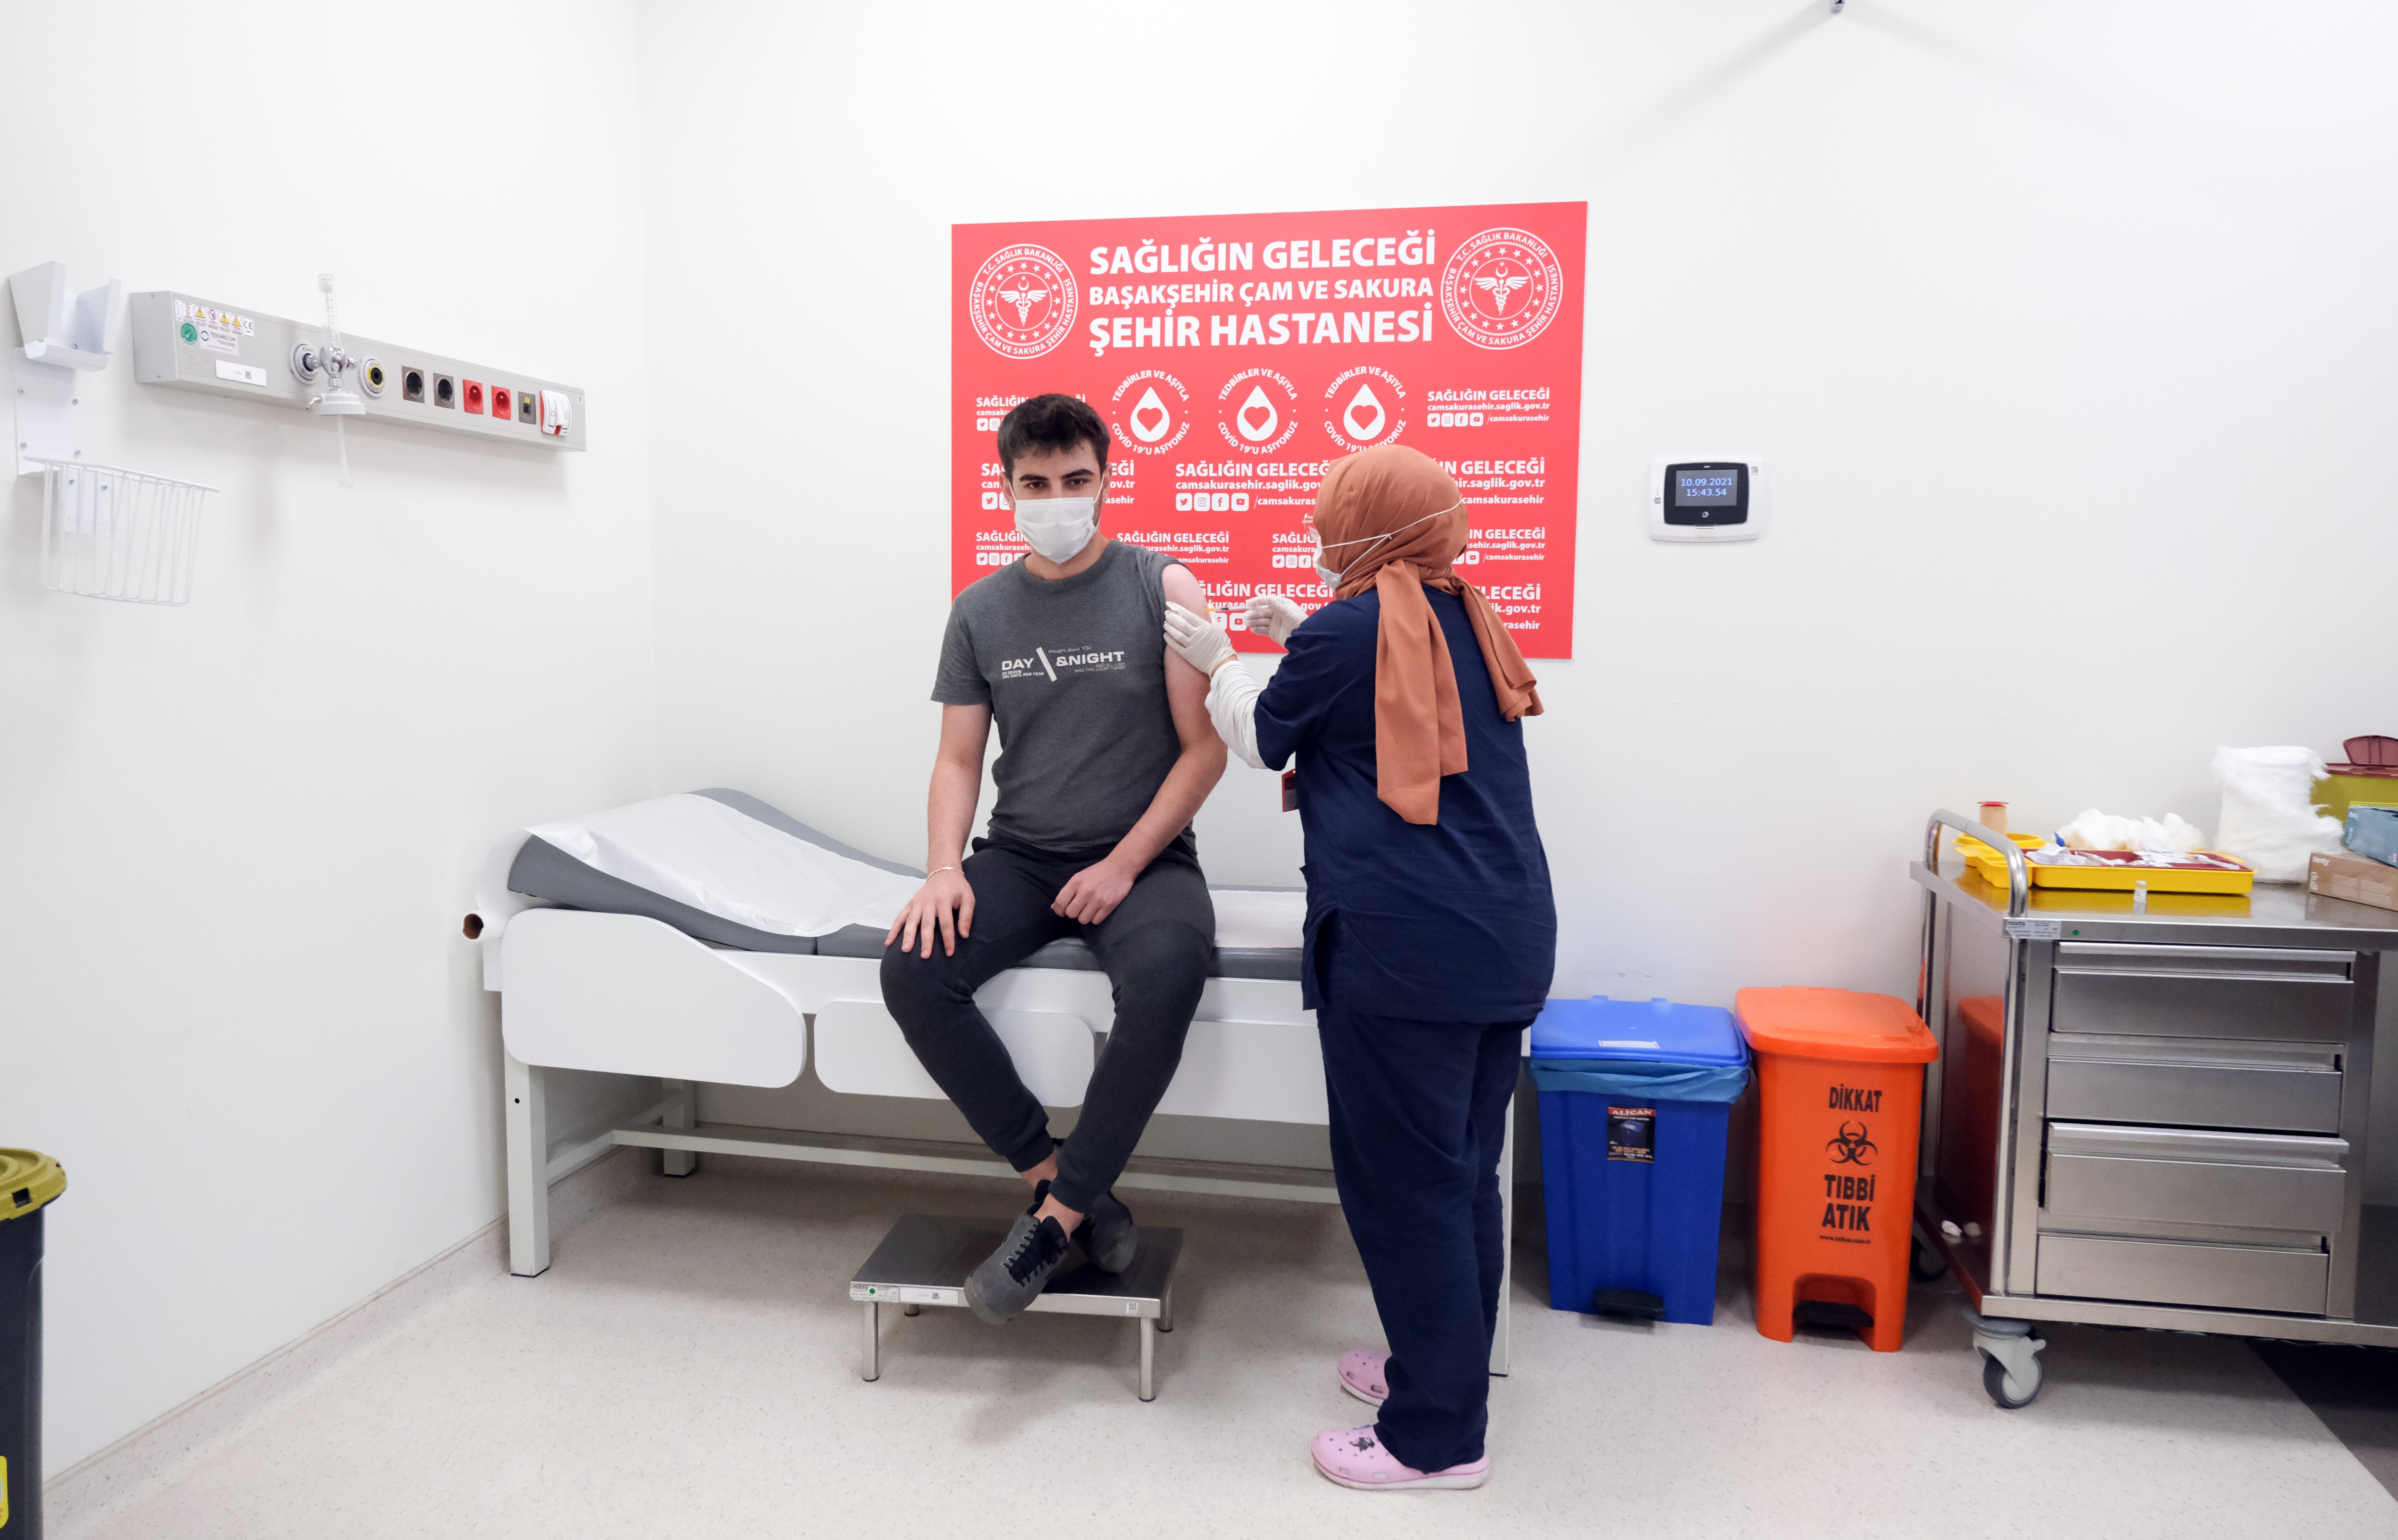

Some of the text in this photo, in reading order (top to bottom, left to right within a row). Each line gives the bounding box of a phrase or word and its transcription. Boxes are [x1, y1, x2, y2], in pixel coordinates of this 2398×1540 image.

[1090, 229, 1435, 275] SAĞLIĞIN GELECEĞİ
[1456, 232, 1548, 261] T.C. SAĞLIK BAKANLIĞI
[983, 248, 1064, 275] T.C. SAĞLIK BAKANLIĞI
[1089, 277, 1434, 309] BAŞAKŞEHİR ÇAM VE SAKURA
[1444, 264, 1558, 345] BAŞAKŞEHİR ÇAM VE SAKURA ŞEHİR HASTANESİ
[973, 278, 1074, 354] BAŞAKŞEHİR ÇAM VE SAKURA ŞEHİR HASTANESİ
[1089, 302, 1432, 357] ŞEHİR HASTANESİ
[1112, 370, 1190, 402] TEDBİRLER VE AŞIYLA
[1218, 368, 1298, 401] TEDBİRLER VE AŞIYLA
[1324, 366, 1406, 399] TEDBİRLER VE AŞIYLA
[1428, 387, 1550, 401] SAĞLIĞIN GELECEĞİ
[1428, 402, 1550, 411] camsakurasehir.saglik.gov.tr
[1487, 414, 1550, 425] /camsakurasehir
[1112, 423, 1132, 448] COVİD
[1154, 421, 1190, 455] AŞIYORUZ
[1218, 421, 1239, 447] COVİD
[1261, 420, 1298, 454] AŞIYORUZ
[1324, 421, 1345, 446] COVİD
[1368, 419, 1406, 448] YORUZ
[1176, 460, 1330, 477] SAĞLIĞIN GELECEĞ
[1461, 457, 1545, 475] GELECEĞİ
[1176, 479, 1320, 492] camsakurasehir.saglik.go
[1453, 477, 1545, 490] hir.saglik.gov.tr
[1681, 478, 1732, 486] 10.09.2021
[1254, 495, 1316, 509] /camsakuras
[1117, 531, 1229, 543] SAĞLIĞIN GELECEĞİ
[1272, 532, 1315, 543] SAĞLI
[1485, 527, 1545, 539] GELECEĞİ
[1467, 541, 1546, 551] sehir.saglik.gov.tr
[1482, 552, 1545, 563] /camsakurasehir
[1474, 583, 1541, 600] LECEĞİ
[1002, 651, 1124, 671] DAY &NIGHT
[1829, 1083, 1882, 1113] DİKKAT
[1824, 1174, 1876, 1202] TIBBİ
[1822, 1202, 1871, 1232] ATIK
